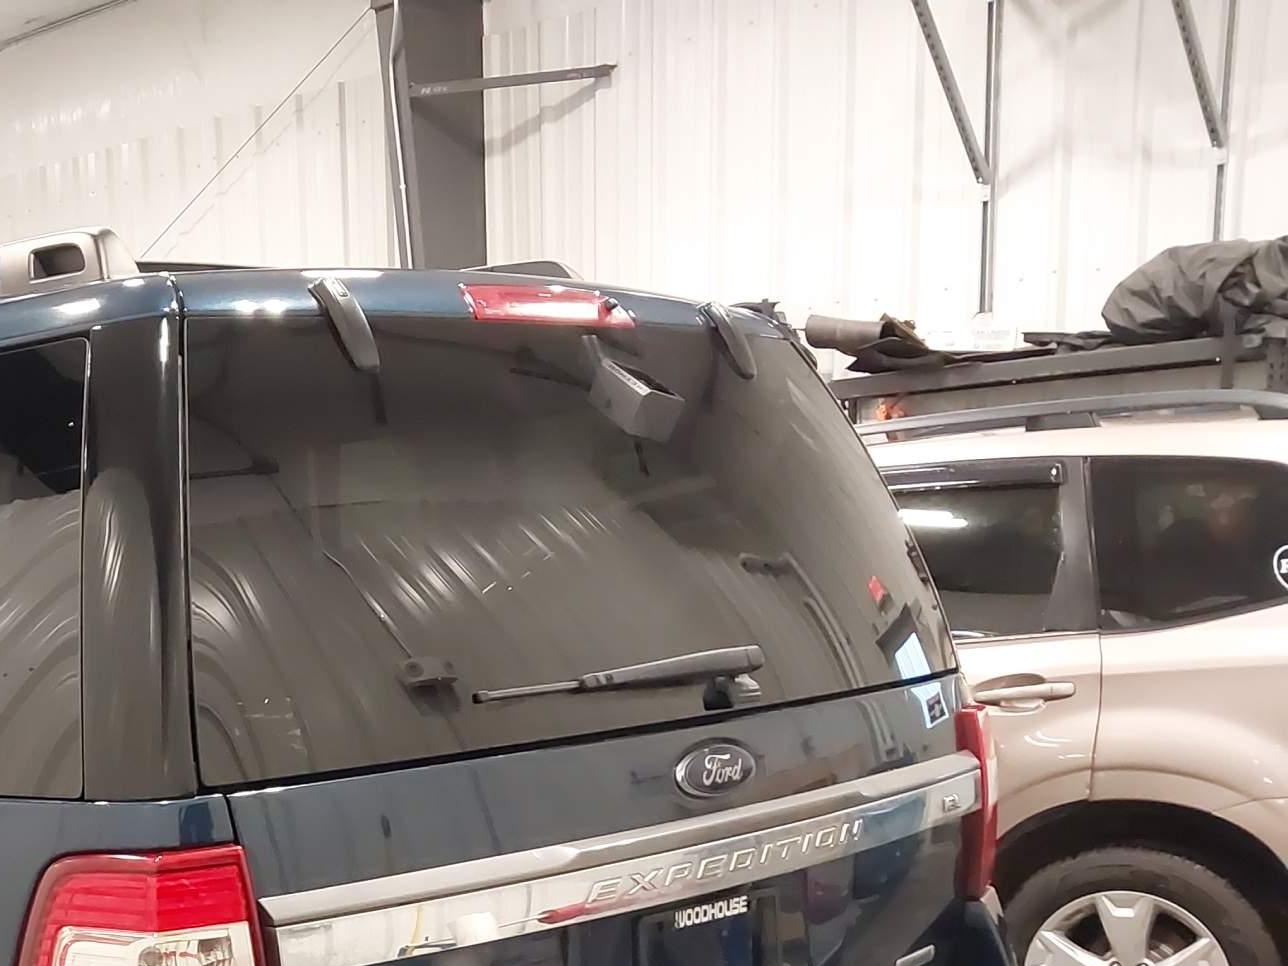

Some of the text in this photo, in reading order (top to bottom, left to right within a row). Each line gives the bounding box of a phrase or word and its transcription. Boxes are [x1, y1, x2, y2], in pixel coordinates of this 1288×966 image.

[703, 753, 743, 786] Ford
[585, 817, 864, 904] EXPEDITION
[674, 895, 749, 929] WOODHOUSE
